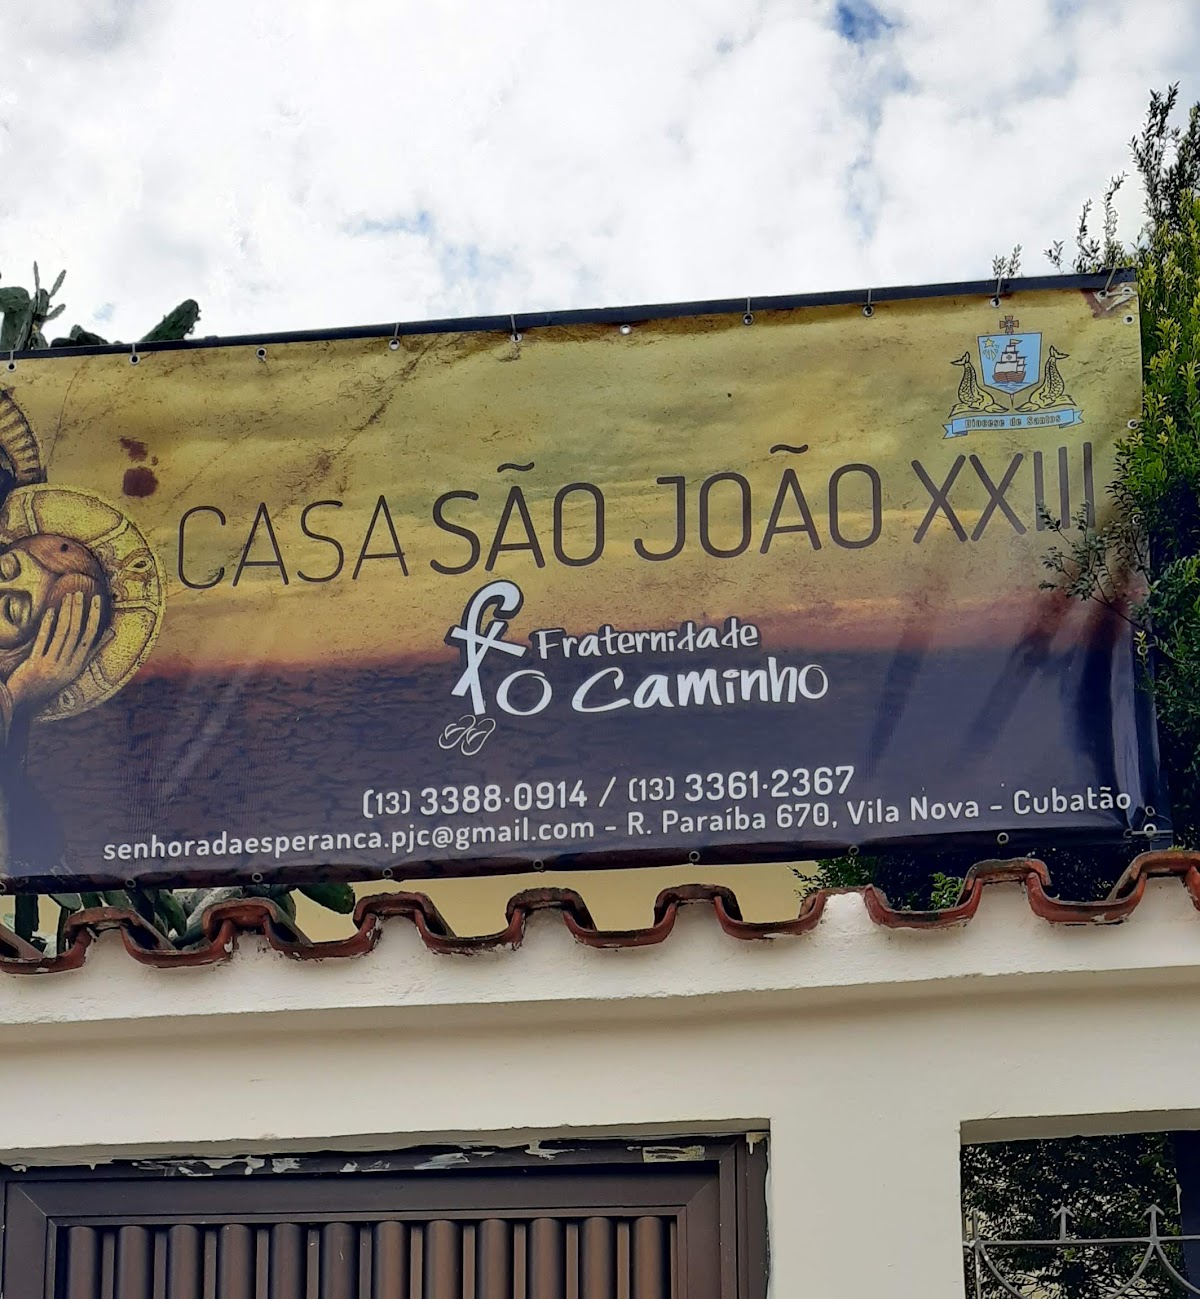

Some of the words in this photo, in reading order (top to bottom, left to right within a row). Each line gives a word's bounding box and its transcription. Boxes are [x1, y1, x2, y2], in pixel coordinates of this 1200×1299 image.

[964, 418, 1005, 429] Diocese
[1009, 416, 1022, 427] de
[1026, 414, 1061, 425] Santos
[177, 494, 409, 590] CASA
[429, 462, 606, 575] SÃO
[633, 444, 883, 562] JOÃO
[910, 441, 1096, 545] XXIII
[536, 617, 759, 660] Fraternidade
[570, 656, 829, 713] Caminho
[362, 788, 412, 819] (13)
[628, 776, 676, 803] (13)
[103, 816, 595, 861] senhoradaesperanca.pjc@gmail.com
[627, 811, 652, 836] R.
[662, 806, 766, 835] Paraíba
[775, 801, 838, 830] 670,
[846, 798, 900, 826] Vila
[910, 795, 980, 822] Nova
[1012, 785, 1132, 816] Cubatão
